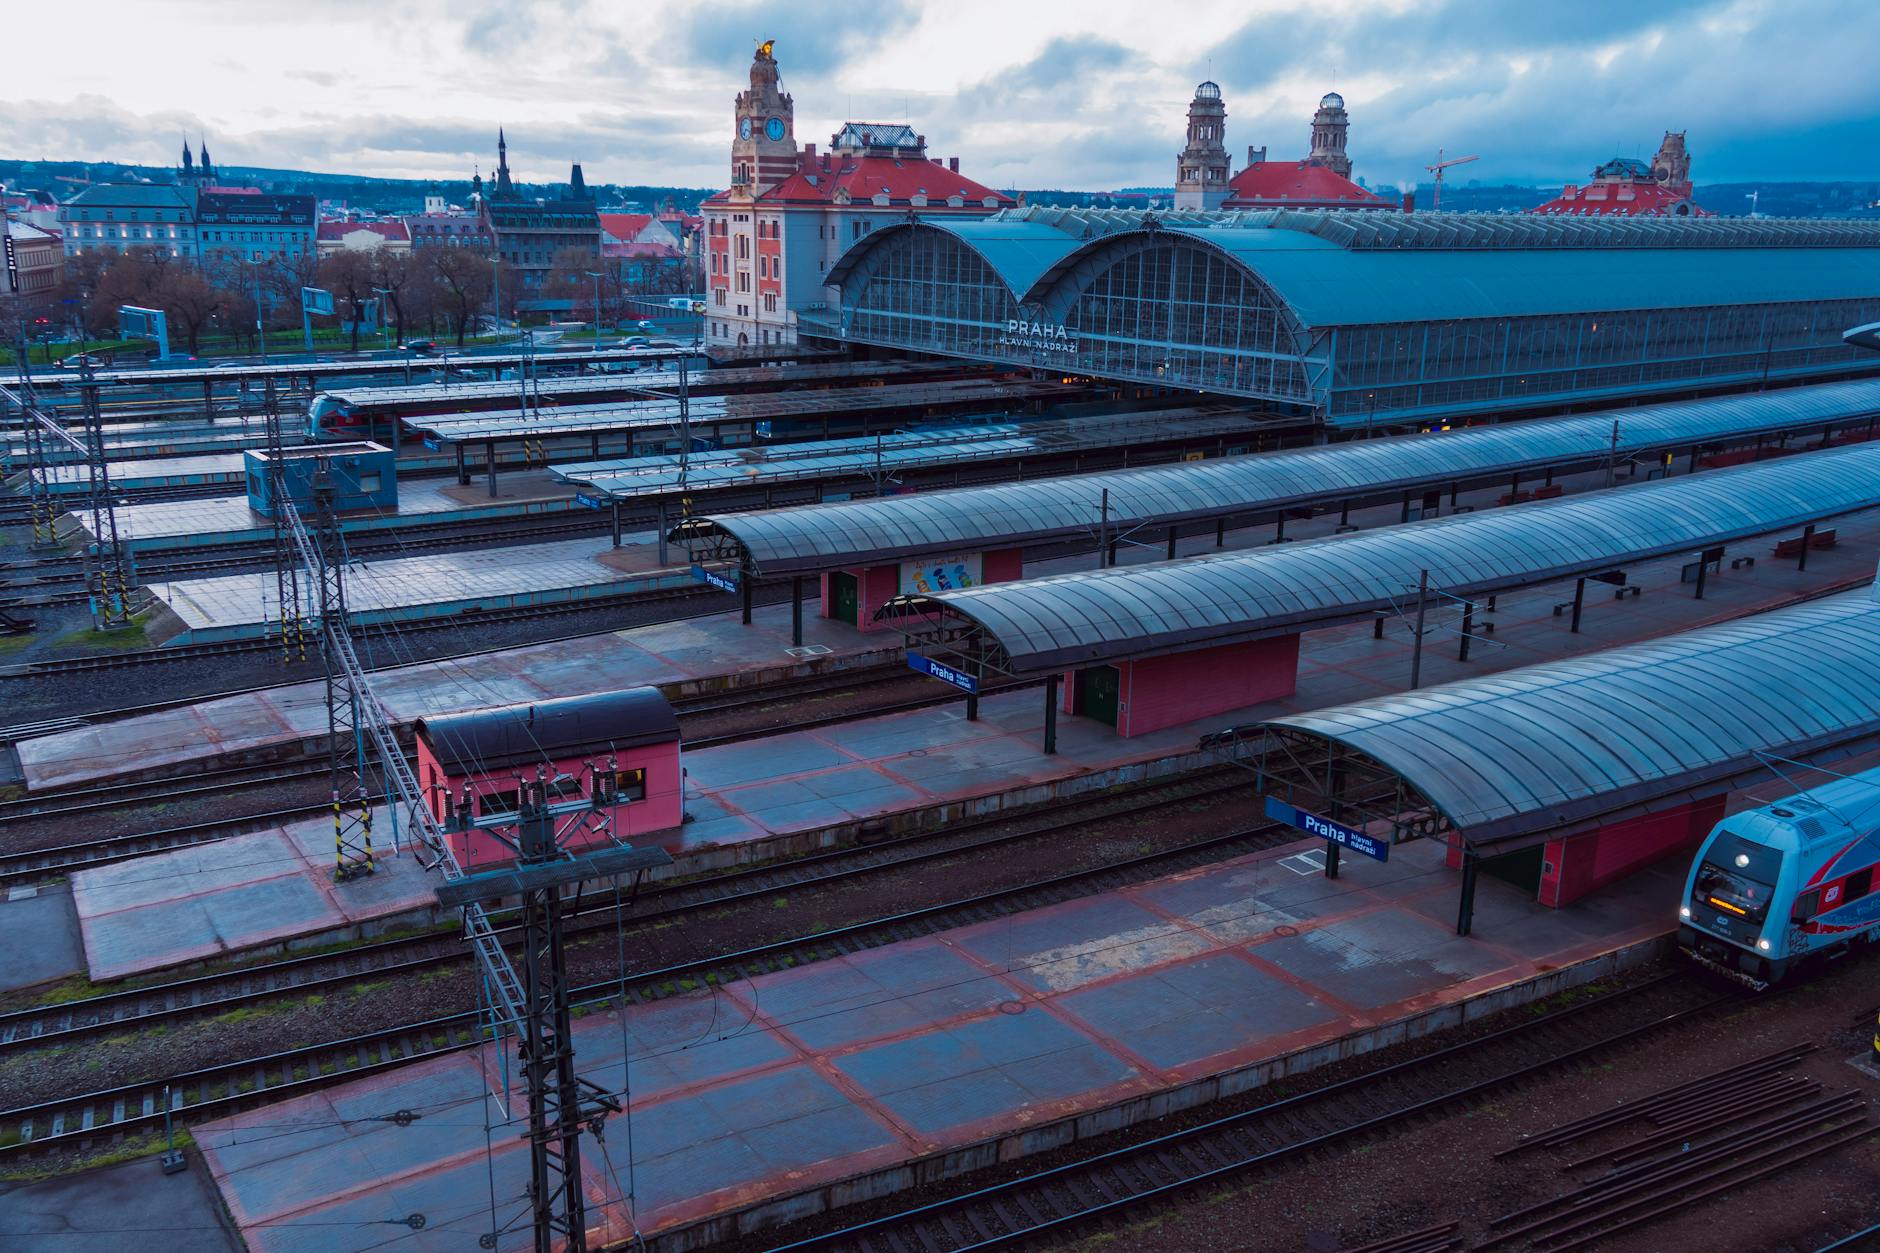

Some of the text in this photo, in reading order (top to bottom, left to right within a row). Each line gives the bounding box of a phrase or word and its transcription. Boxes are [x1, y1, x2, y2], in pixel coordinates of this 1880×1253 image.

[1009, 320, 1067, 339] PRAHA
[706, 573, 724, 588] Praha
[930, 663, 954, 682] Praha
[1305, 816, 1346, 843] Praha
[1351, 833, 1372, 846] hlavní
[1351, 841, 1376, 855] nádraží
